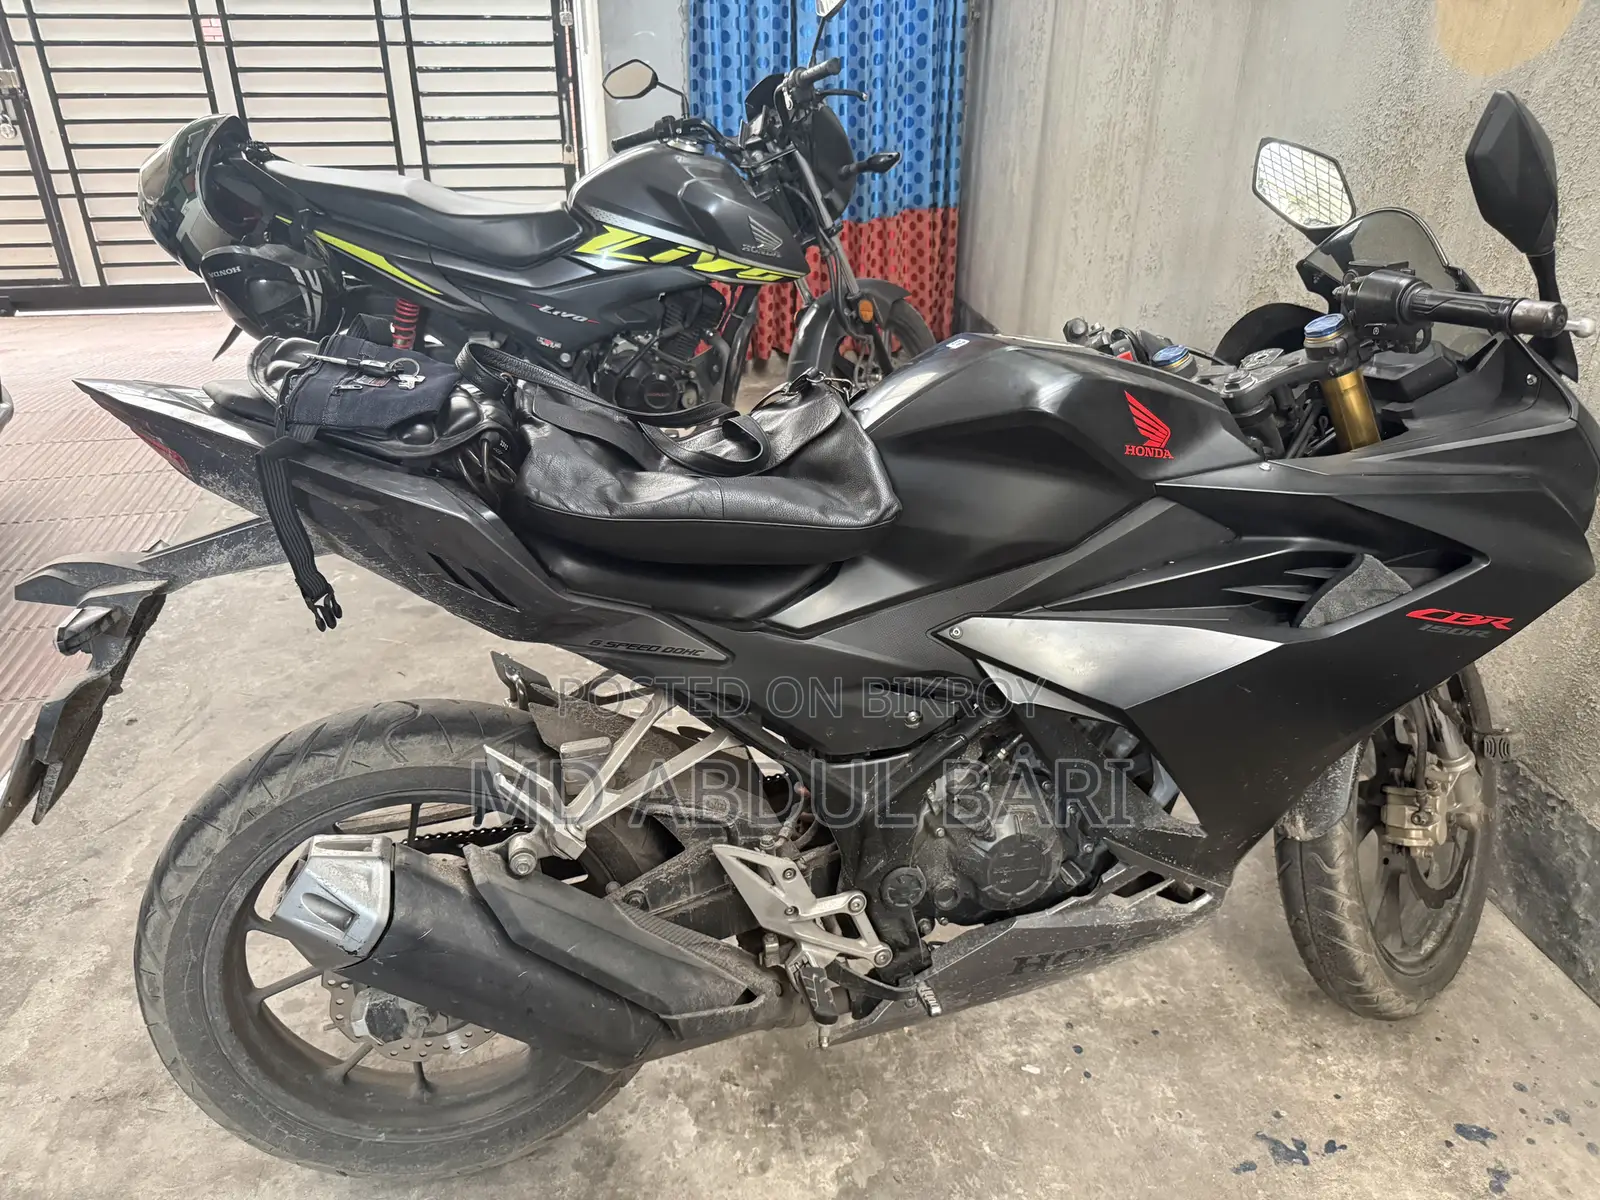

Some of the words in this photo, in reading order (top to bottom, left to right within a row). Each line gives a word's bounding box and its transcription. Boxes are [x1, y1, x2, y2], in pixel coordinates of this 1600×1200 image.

[208, 265, 242, 278] HONDA
[1124, 444, 1175, 459] HONDA
[1405, 608, 1514, 630] CBR
[1418, 623, 1493, 638] 150R
[603, 641, 662, 652] SPEED
[661, 646, 705, 657] DOHC
